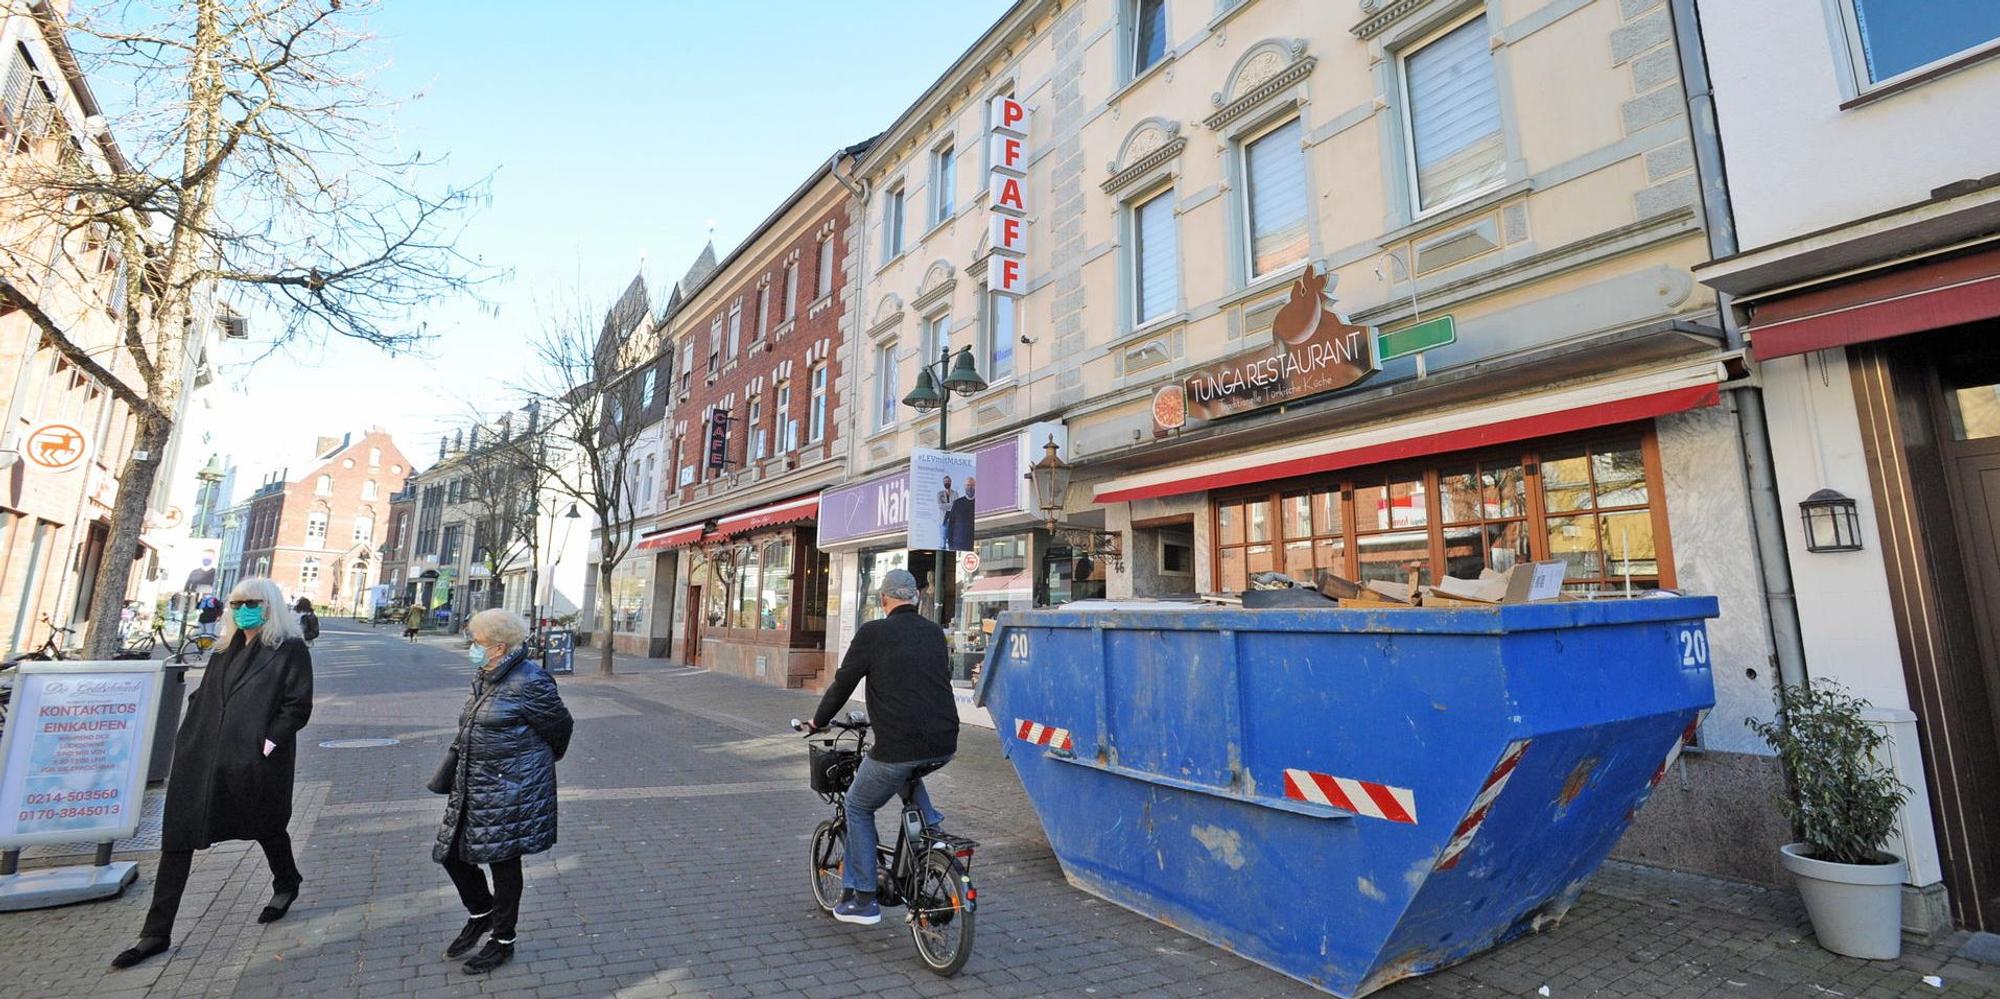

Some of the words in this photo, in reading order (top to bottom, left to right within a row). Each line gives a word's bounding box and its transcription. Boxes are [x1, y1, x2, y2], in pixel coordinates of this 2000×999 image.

[1000, 100, 1023, 289] PFAFF
[1191, 369, 1246, 402] TUNGA
[1246, 331, 1361, 387] RESTAURANT
[1010, 633, 1029, 659] 20
[1680, 629, 1706, 666] 20
[39, 704, 137, 718] KONTAKTLOS
[44, 719, 127, 733] EINKAUFEN
[27, 789, 119, 805] 0214-503560
[19, 804, 120, 821] 0170-3845013
